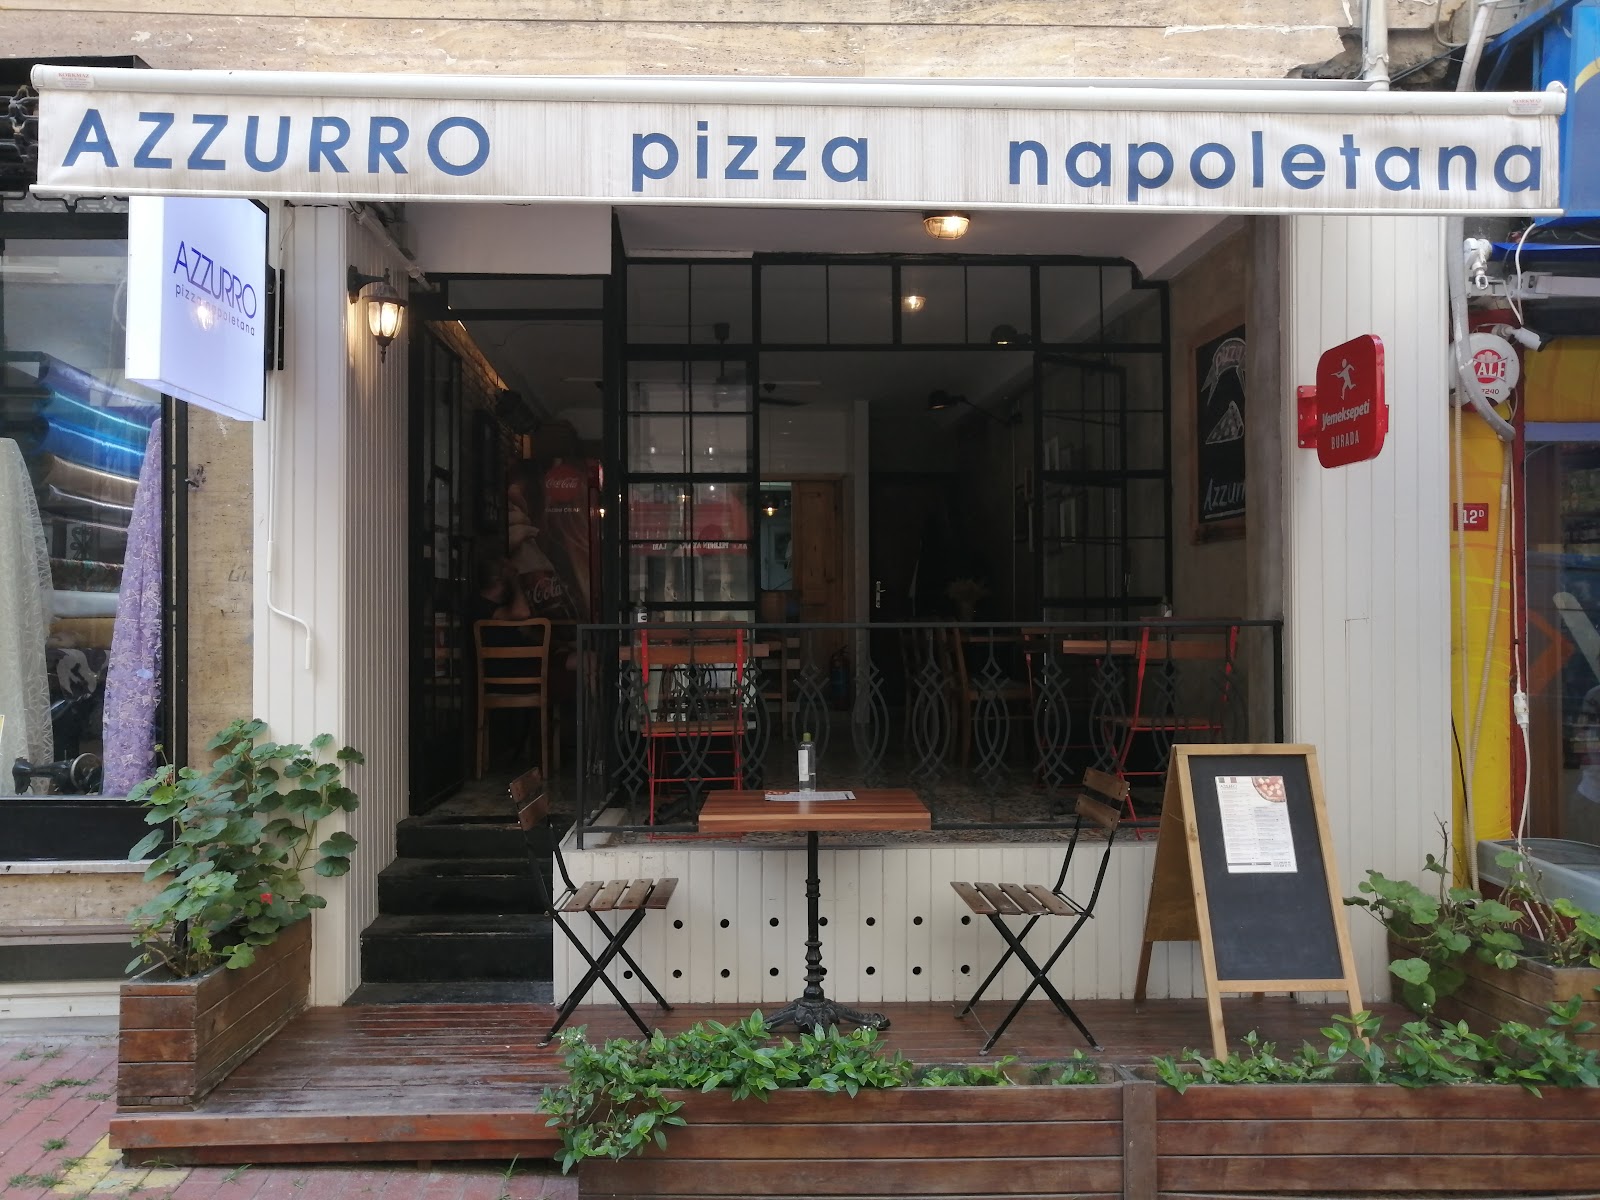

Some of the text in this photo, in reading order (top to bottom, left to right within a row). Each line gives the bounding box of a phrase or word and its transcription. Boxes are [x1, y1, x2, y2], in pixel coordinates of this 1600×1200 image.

[62, 108, 1542, 203] AZZURRO pizza napoletana
[173, 240, 257, 319] AZZURRO
[1330, 430, 1360, 450] BURADA
